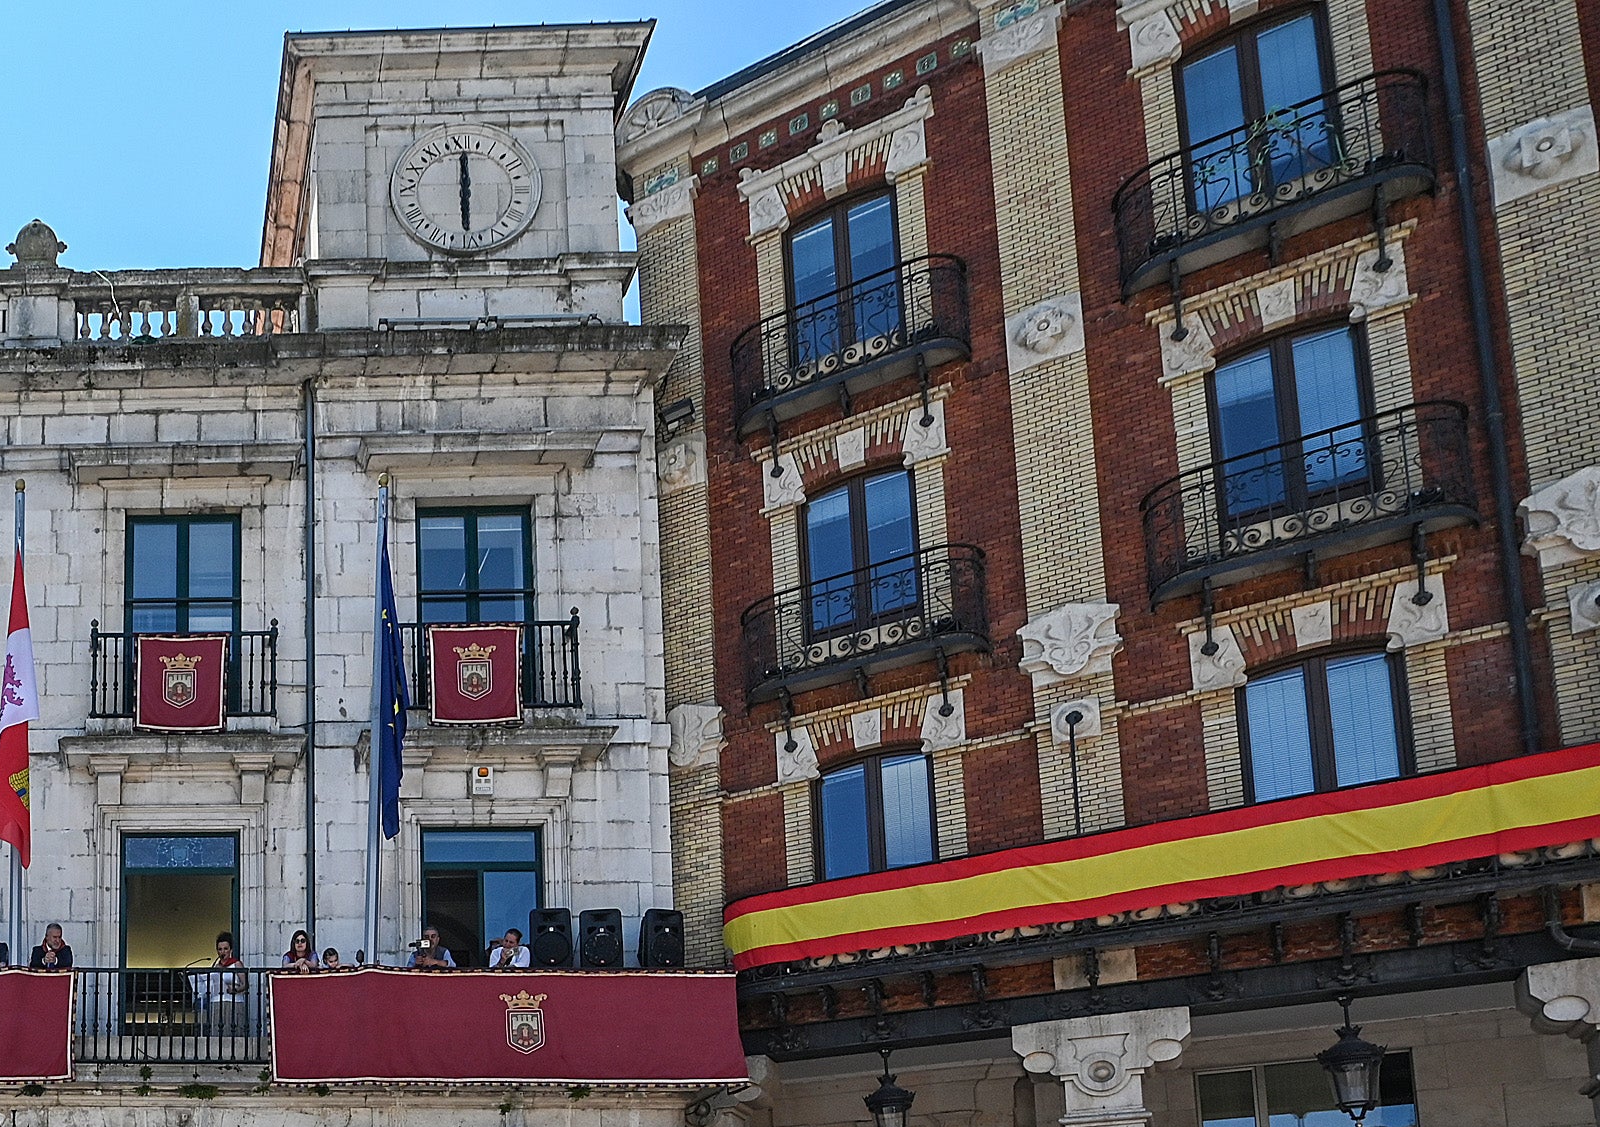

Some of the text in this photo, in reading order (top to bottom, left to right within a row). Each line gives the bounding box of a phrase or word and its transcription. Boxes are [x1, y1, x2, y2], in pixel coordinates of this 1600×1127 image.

[422, 142, 441, 158] XI
[451, 136, 470, 150] XII
[406, 161, 424, 177] X
[505, 158, 522, 172] II
[514, 185, 530, 194] III
